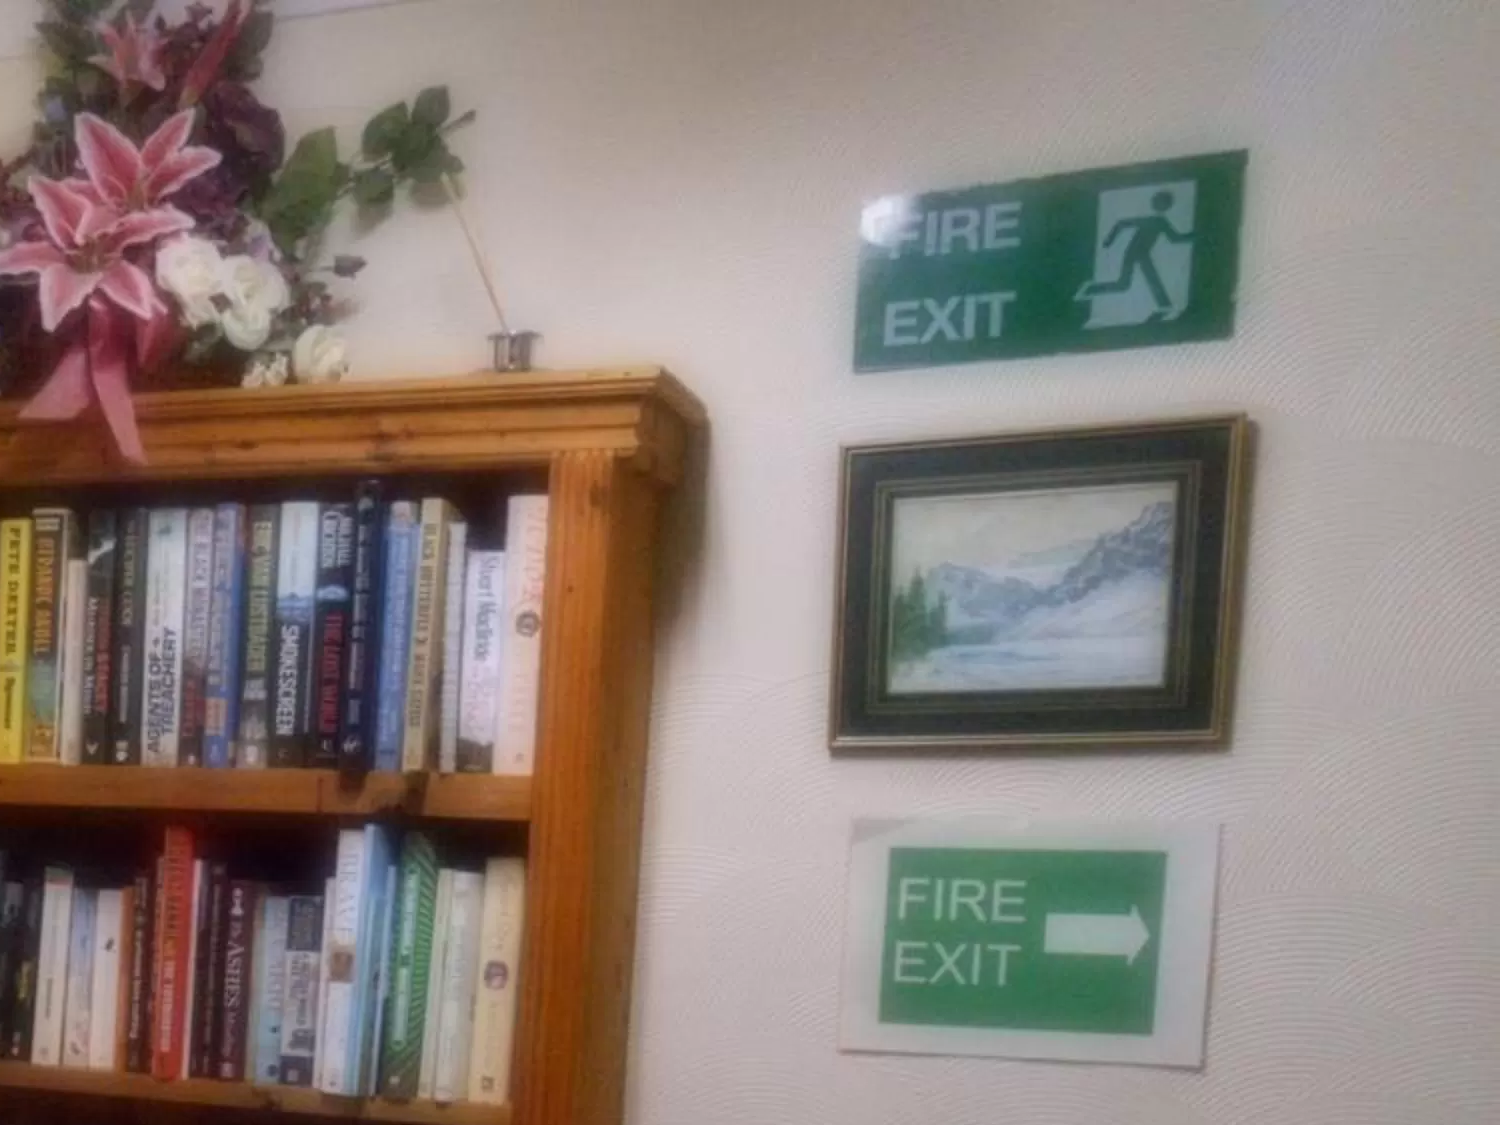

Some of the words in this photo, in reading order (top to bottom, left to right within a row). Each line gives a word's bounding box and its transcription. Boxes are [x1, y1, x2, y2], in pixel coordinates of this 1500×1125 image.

[888, 201, 1024, 260] FIRE
[882, 291, 1017, 348] EXIT
[6, 527, 21, 575] PETE
[4, 580, 19, 656] DEXTER
[161, 627, 177, 736] TREACHERY
[275, 625, 299, 736] SMOKESCREEN
[146, 675, 161, 754] AGENTS
[897, 877, 1027, 923] FIRE
[893, 941, 1022, 987] EXIT
